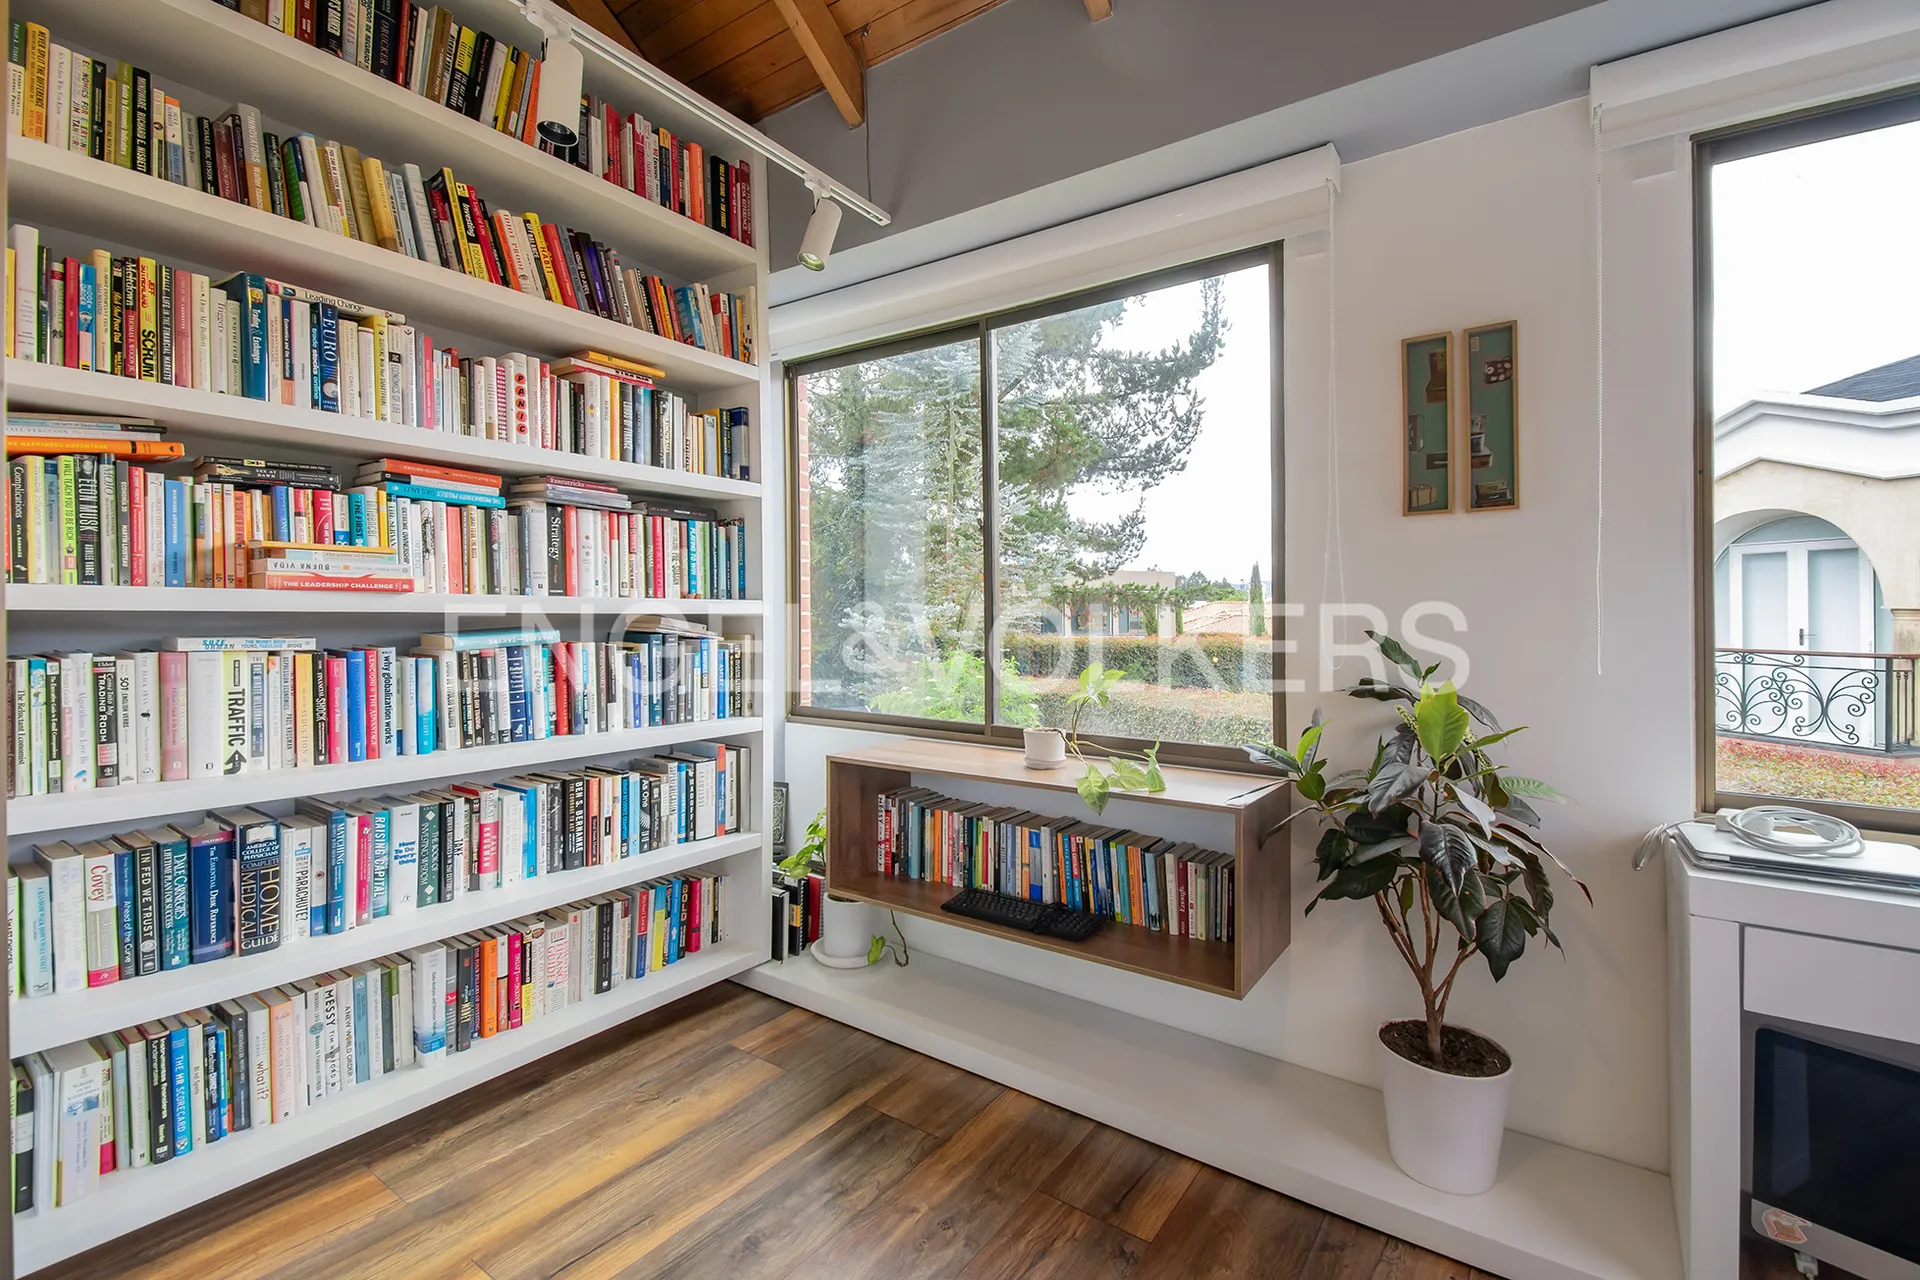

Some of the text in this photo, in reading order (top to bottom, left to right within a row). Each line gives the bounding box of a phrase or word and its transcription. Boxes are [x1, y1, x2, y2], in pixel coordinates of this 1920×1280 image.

[379, 20, 390, 65] DRUCKER
[137, 111, 147, 138] RICHARD
[137, 146, 147, 172] NISBETT
[205, 160, 213, 180] DYSON
[462, 203, 476, 237] Investing
[472, 249, 484, 280] DUMMIES
[512, 243, 524, 272] PROOF
[540, 246, 554, 275] HABIT
[125, 262, 137, 306] Meltdown
[217, 302, 226, 333] Triggers
[250, 309, 261, 328] Trading
[142, 329, 156, 377] SCRUM
[251, 336, 262, 364] Exchanges
[322, 318, 338, 362] EURO
[391, 364, 401, 393] ECONOMICS
[392, 403, 401, 414] LIFE
[517, 375, 526, 433] PANIC
[14, 467, 26, 518] Complications
[104, 466, 115, 495] MOJO
[78, 478, 99, 532] ELON MUSK
[366, 500, 378, 537] Influencer
[402, 531, 410, 565] OWNERSHIP
[548, 516, 561, 560] Strategy
[106, 673, 114, 691] Come
[77, 691, 87, 728] Algorithms
[99, 674, 107, 742] TRADING ROOM
[381, 656, 393, 744] why globalization works
[18, 702, 26, 732] Reluctant
[228, 688, 246, 747] TRAFFIC
[18, 733, 26, 765] Economist
[79, 739, 87, 754] Live
[575, 781, 584, 798] BEN
[642, 791, 650, 808] One
[246, 840, 277, 850] AMERICAN
[336, 822, 345, 865] MATCHING
[398, 840, 416, 848] How
[431, 831, 439, 842] THE
[574, 810, 584, 853] BERNANKE
[241, 859, 279, 870] COMPLETE
[374, 817, 387, 897] RAISING CAPITAL
[431, 845, 439, 860] BOOK
[89, 865, 107, 901] Covey
[141, 853, 153, 937] IN FED WE TRUST
[295, 871, 309, 922] PARACHUTE?
[210, 890, 219, 909] DESK
[240, 866, 280, 939] HOME MEDICAL
[123, 901, 132, 963] Ahead of the Curve
[241, 933, 279, 950] GUIDE
[325, 988, 336, 1027] MESSY
[255, 1061, 267, 1086] what
[175, 1055, 185, 1132] THE HR SCORECARD
